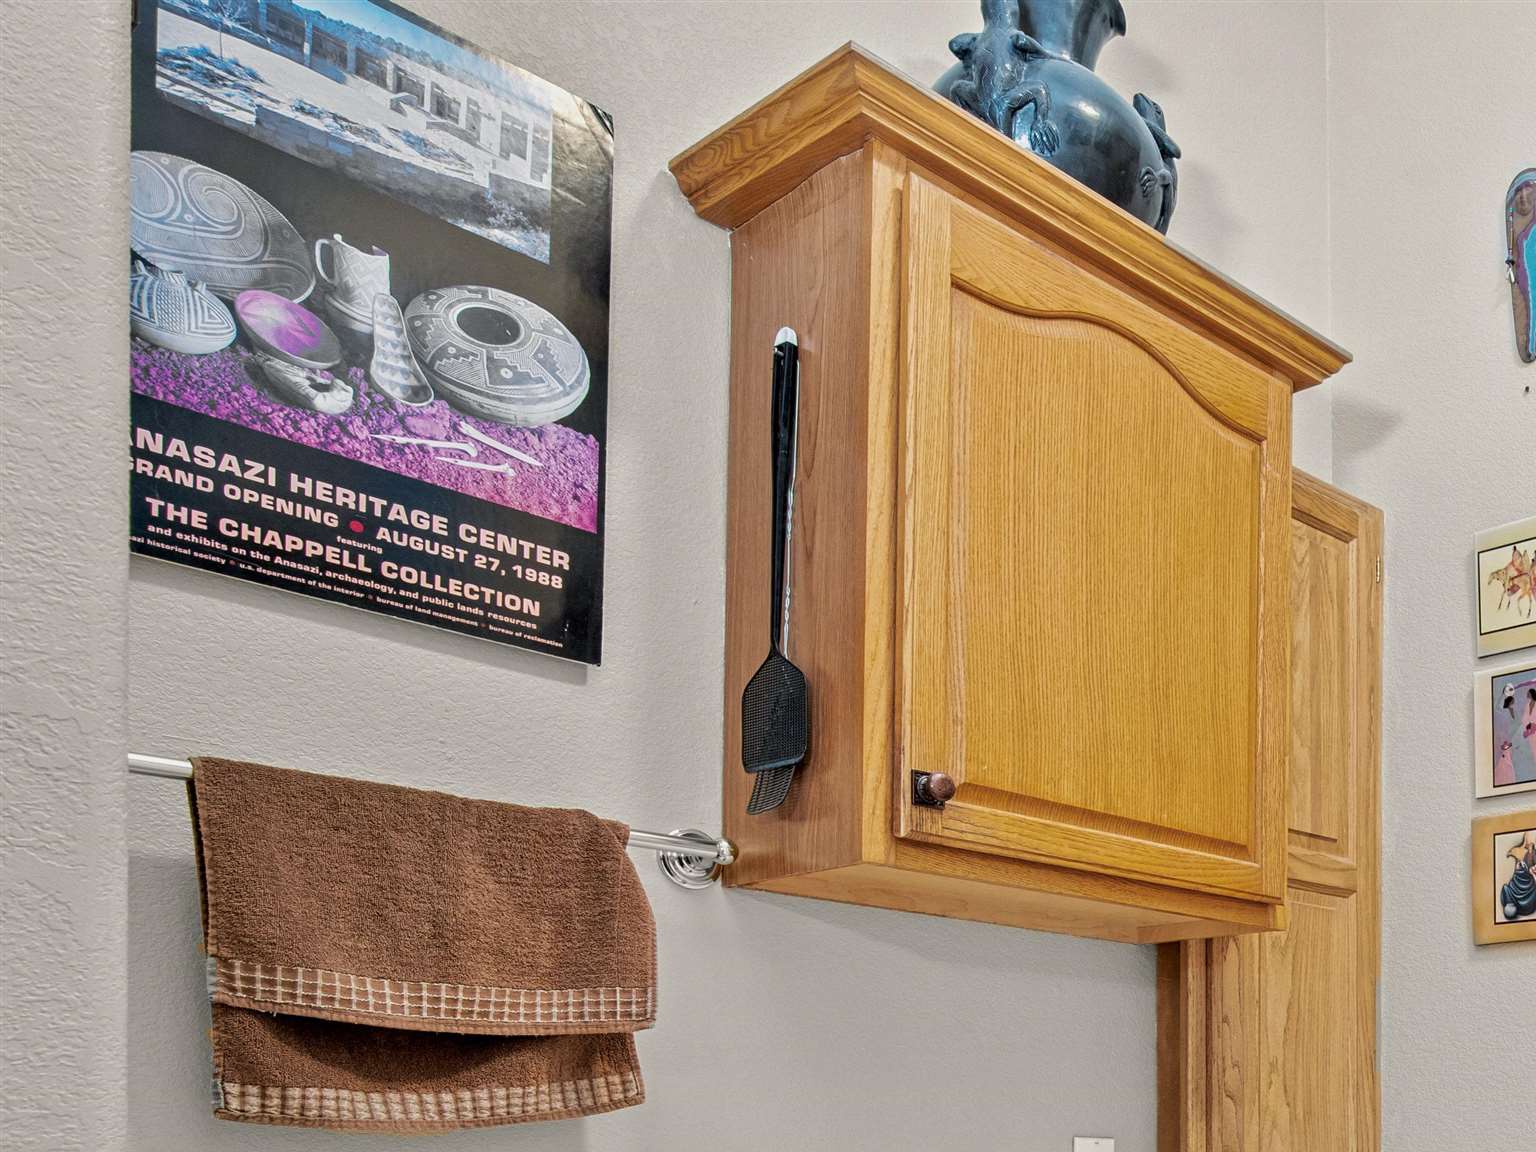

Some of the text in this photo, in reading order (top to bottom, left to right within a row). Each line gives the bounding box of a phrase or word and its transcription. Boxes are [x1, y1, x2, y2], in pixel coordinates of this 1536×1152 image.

[129, 427, 571, 571] NASAZI HERITAGE CENTER
[223, 484, 339, 528] OPENING
[376, 527, 469, 563] AUGUST
[474, 554, 506, 577] 27,
[512, 565, 563, 589] 1988
[336, 535, 383, 555] featuring
[145, 497, 541, 617] THE CHAPPELL COLLECTION
[146, 538, 192, 555] historical
[193, 551, 226, 565] society
[256, 567, 306, 584] department
[318, 582, 332, 590] the
[333, 585, 366, 598] interior
[376, 596, 404, 608] bureau
[414, 606, 432, 615] land
[488, 624, 514, 635] bureau
[147, 525, 172, 537] and
[175, 532, 228, 551] exhibits
[231, 546, 247, 556] on
[249, 547, 271, 562] the
[399, 589, 419, 600] and
[422, 595, 455, 609] public
[457, 603, 485, 616] lands
[487, 611, 538, 630] resources
